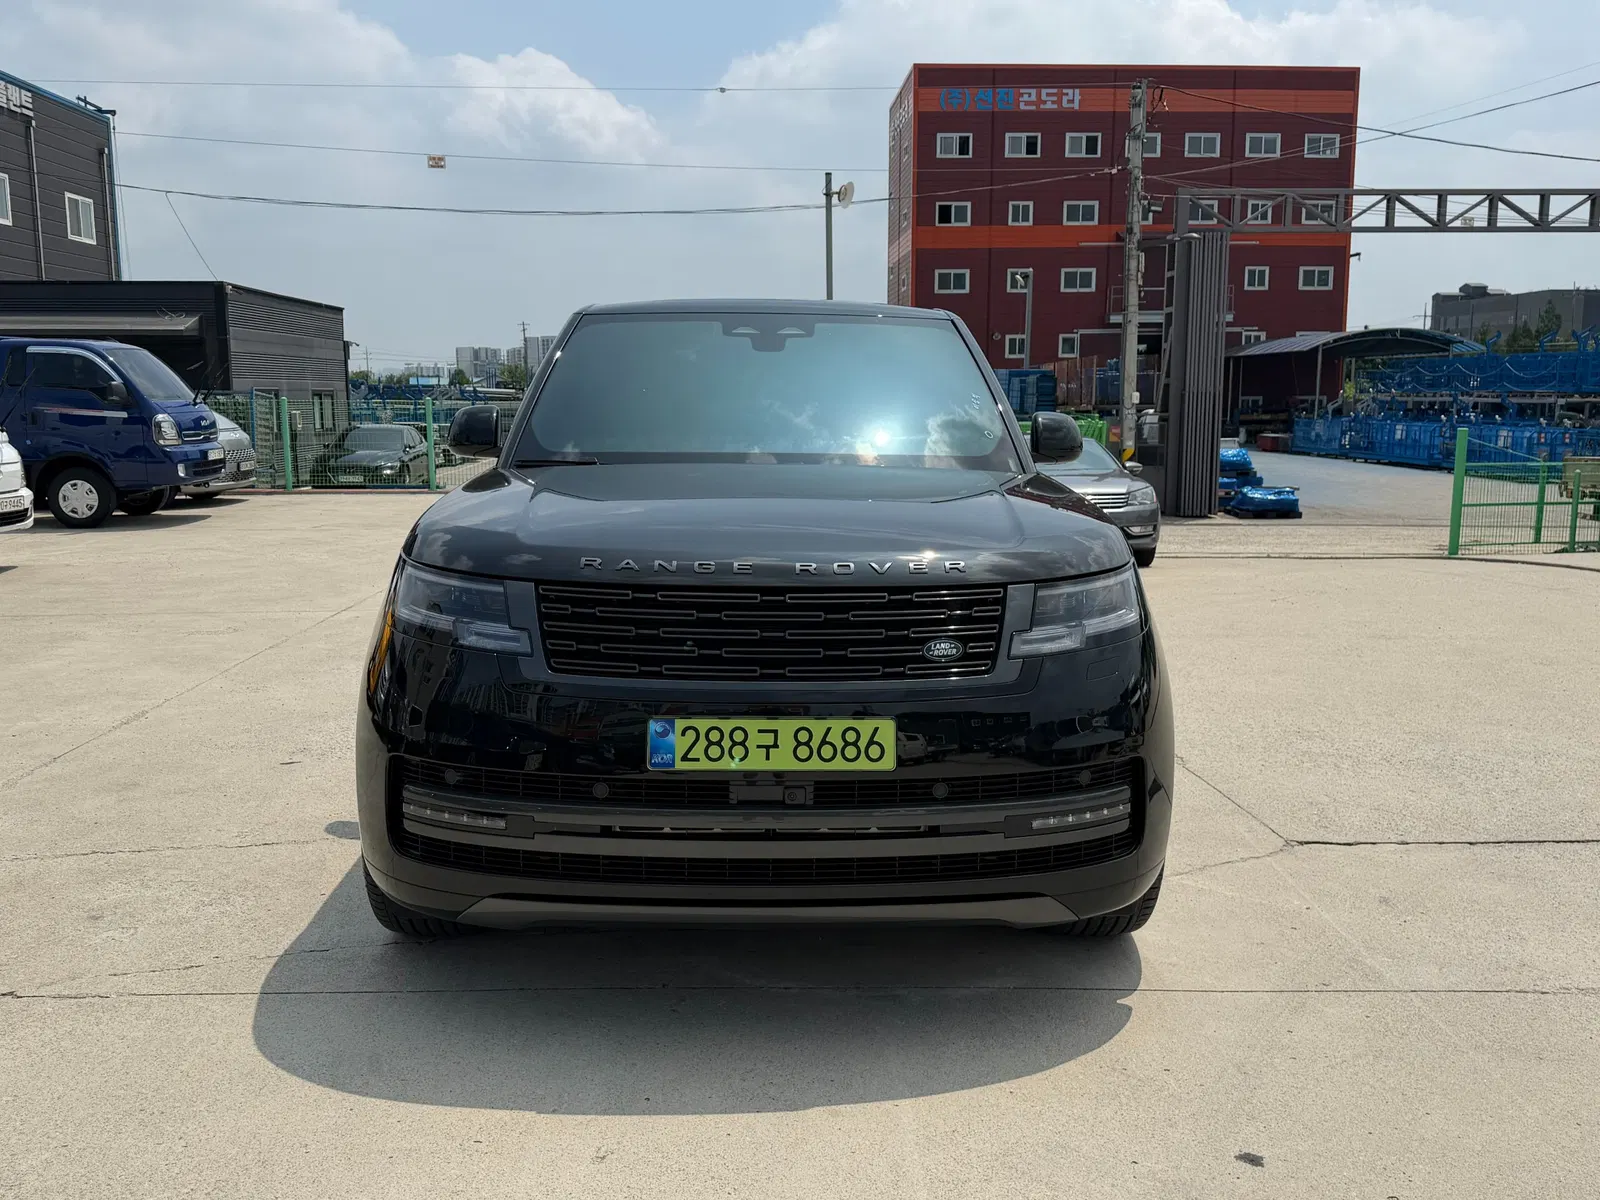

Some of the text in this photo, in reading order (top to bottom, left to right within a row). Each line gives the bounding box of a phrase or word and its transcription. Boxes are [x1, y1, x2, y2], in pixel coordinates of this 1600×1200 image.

[1019, 88, 1081, 110] 곤도라
[579, 556, 967, 576] RANGE ROVER
[931, 642, 951, 650] LAND
[933, 648, 957, 656] ROVER
[792, 726, 886, 763] 8686
[651, 753, 673, 764] KOR
